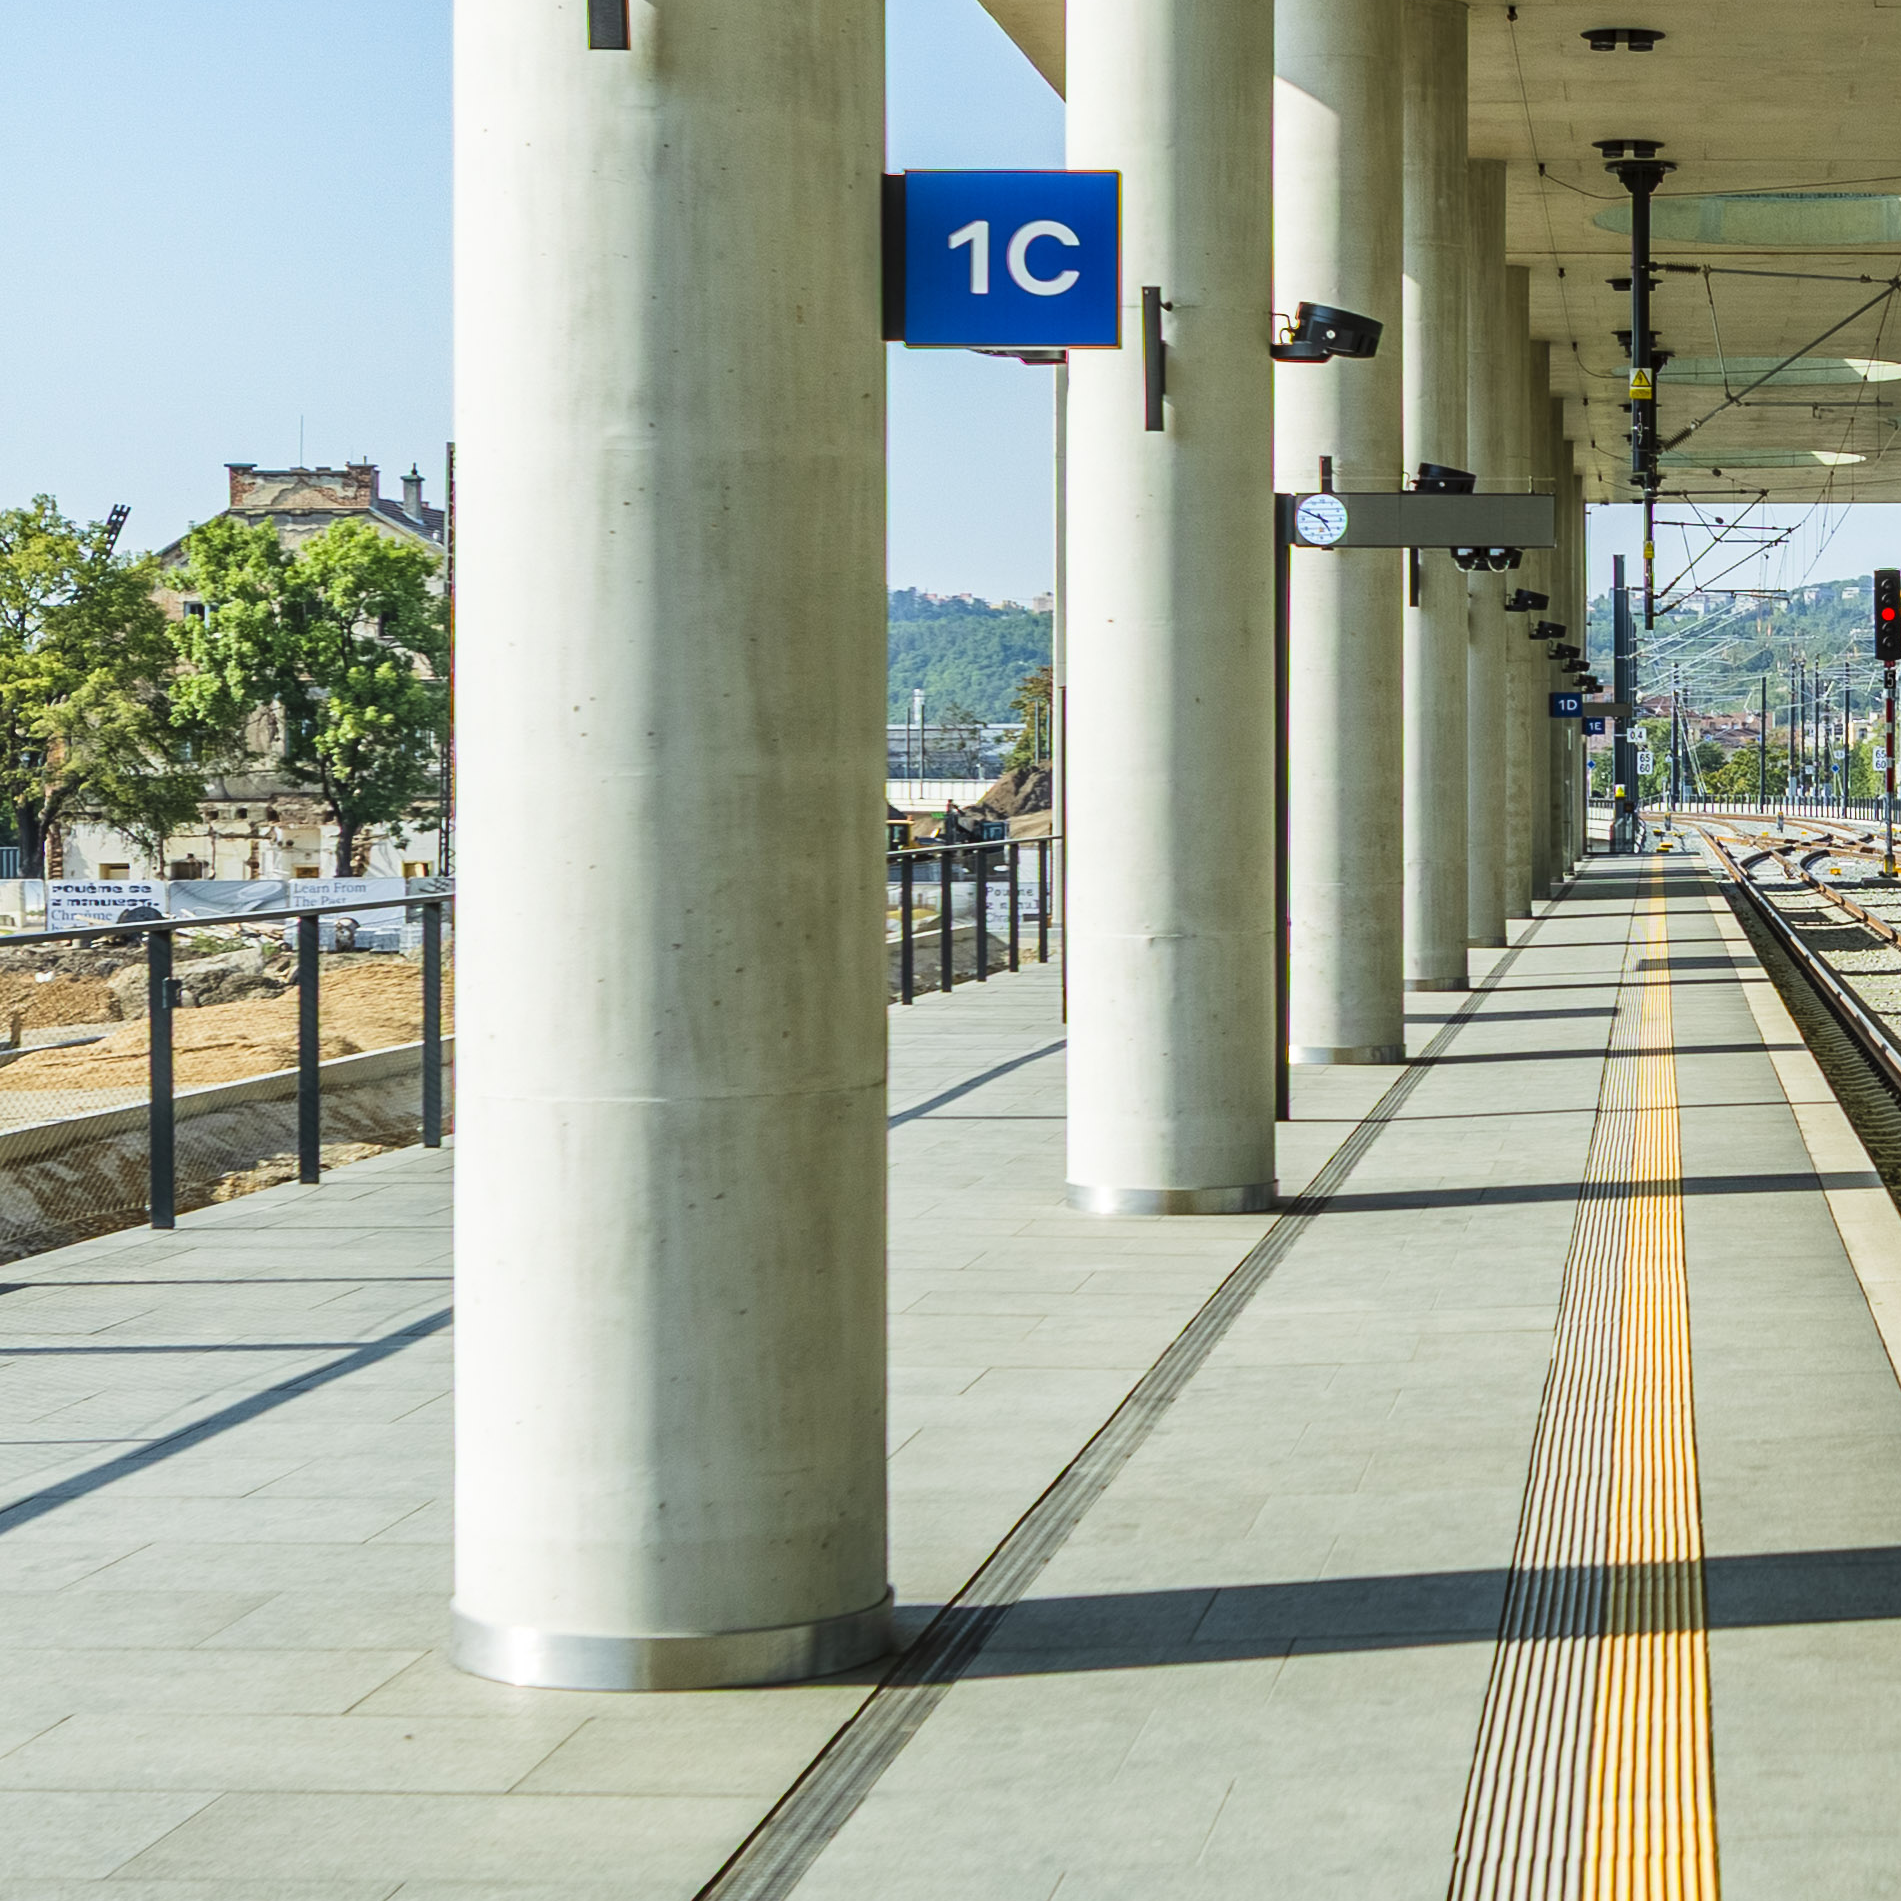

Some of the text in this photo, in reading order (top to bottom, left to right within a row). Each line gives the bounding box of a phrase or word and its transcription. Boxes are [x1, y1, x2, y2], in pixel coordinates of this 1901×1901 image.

[948, 219, 1081, 297] 1C
[1887, 671, 1894, 688] 5
[1558, 699, 1578, 711] 1D
[1589, 722, 1602, 731] 1E
[1640, 753, 1651, 762] 65
[1876, 749, 1887, 759] 65
[1640, 763, 1651, 773] 60
[1876, 760, 1887, 769] 60
[294, 882, 366, 894] Learn From
[294, 896, 318, 907] The
